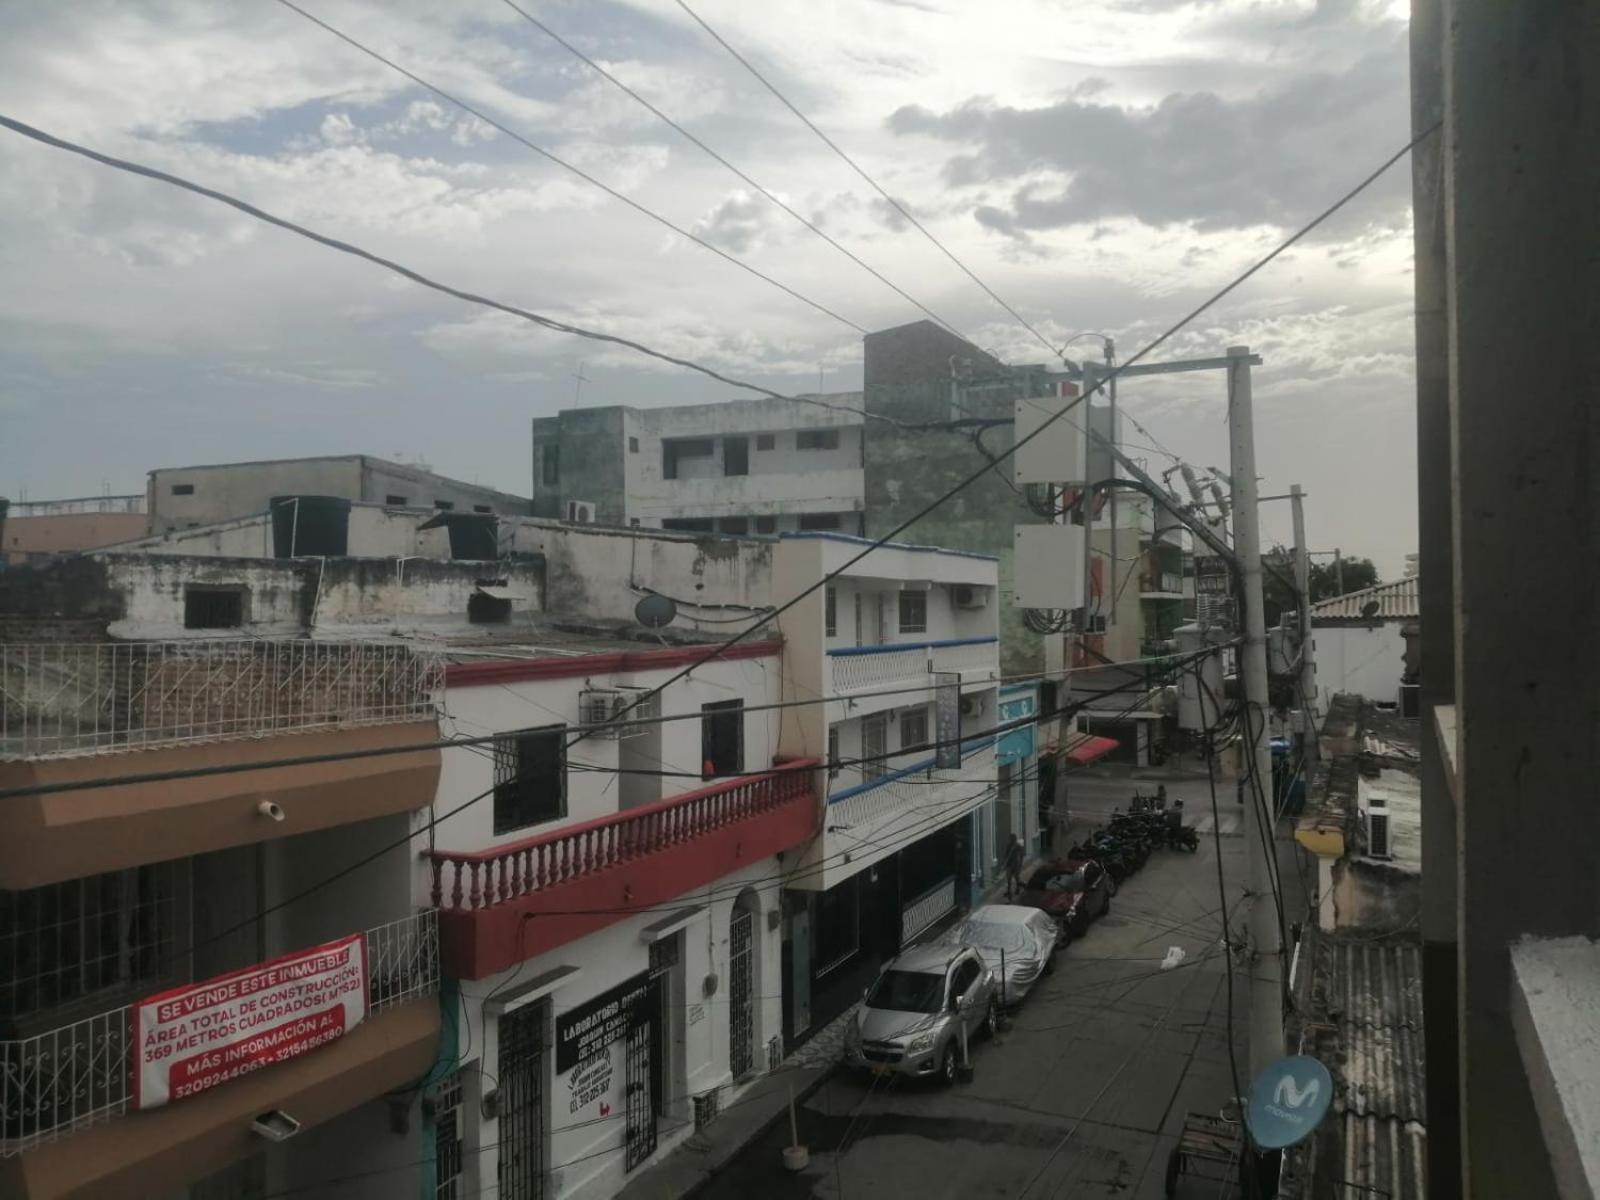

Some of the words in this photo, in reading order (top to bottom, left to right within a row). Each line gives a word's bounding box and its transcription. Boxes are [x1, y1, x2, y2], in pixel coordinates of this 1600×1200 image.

[160, 1004, 182, 1020] SE
[184, 983, 237, 1012] VENDE
[240, 972, 277, 994] ESTE
[145, 1023, 188, 1048] ÁREA
[191, 1008, 236, 1032] TOTAL
[239, 999, 257, 1016] DE
[145, 1045, 173, 1064] 369
[176, 1021, 237, 1052] METROS
[186, 1053, 222, 1076] MÁS
[225, 1017, 317, 1062] INFORMACIÓN
[319, 1012, 333, 1029] AL
